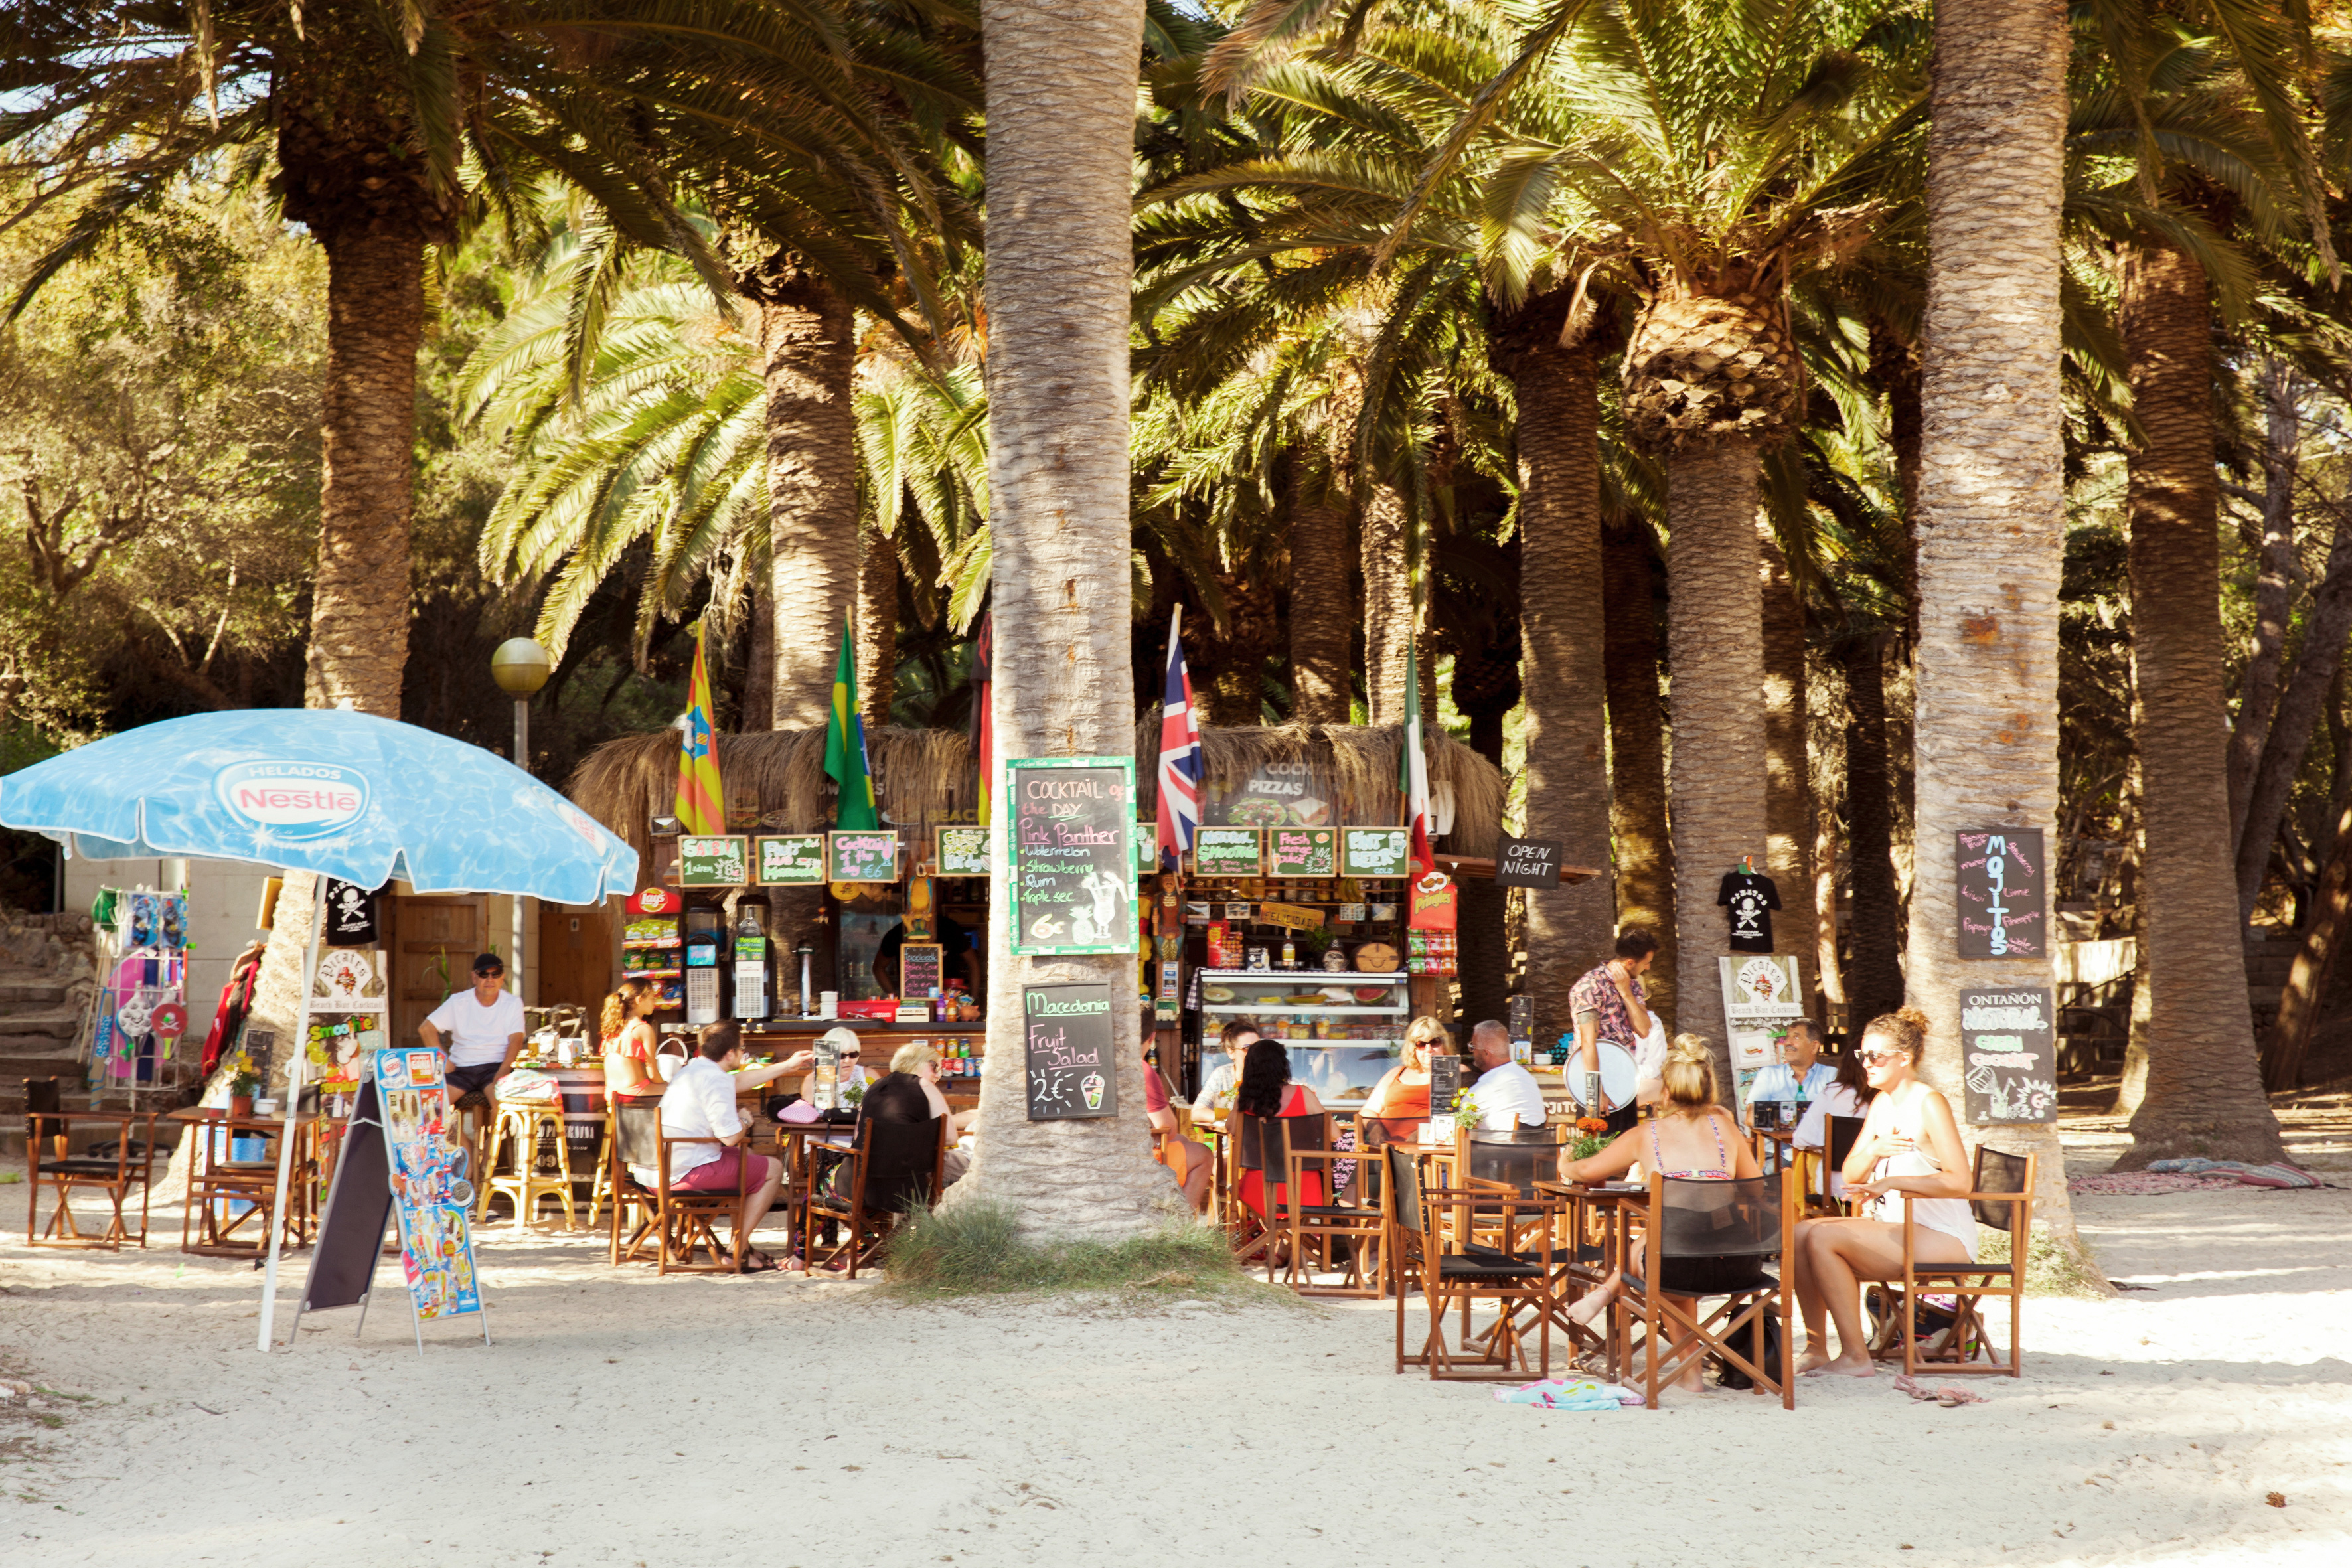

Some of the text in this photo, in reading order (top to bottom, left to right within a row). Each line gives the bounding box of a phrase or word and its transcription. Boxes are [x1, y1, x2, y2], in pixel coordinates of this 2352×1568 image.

[248, 766, 341, 780] HELADOS
[1027, 778, 1104, 799] COCKTAIL
[1248, 779, 1304, 795] PIZZAS
[240, 789, 356, 811] Nestlé
[929, 809, 978, 822] BEAC
[1022, 803, 1082, 817] the DAY
[1018, 818, 1119, 849] Pink Panther
[1025, 844, 1090, 857] Watermelon
[1349, 848, 1395, 868] BEER
[1508, 844, 1551, 860] OPEN
[684, 860, 694, 875] 1
[1026, 858, 1093, 874] Strawberry
[1501, 858, 1553, 876] NIGHT
[1025, 874, 1056, 887] Rum
[640, 893, 666, 907] Lay's
[1023, 888, 1052, 905] Triple
[1414, 890, 1452, 915] Pringles
[1030, 913, 1065, 939] 6€
[1741, 961, 1783, 984] Pirates
[1026, 992, 1110, 1014] Macedonia
[1968, 992, 2042, 1006] ONTAÑÓN
[309, 1016, 373, 1041] Smoothie
[1028, 1024, 1067, 1050] Fruit
[1975, 1035, 2023, 1052] GREEN
[1047, 1046, 1099, 1065] Salad
[1969, 1052, 2039, 1071] COCONUT
[1034, 1078, 1064, 1102] 2€
[2031, 1093, 2051, 1109] 6€
